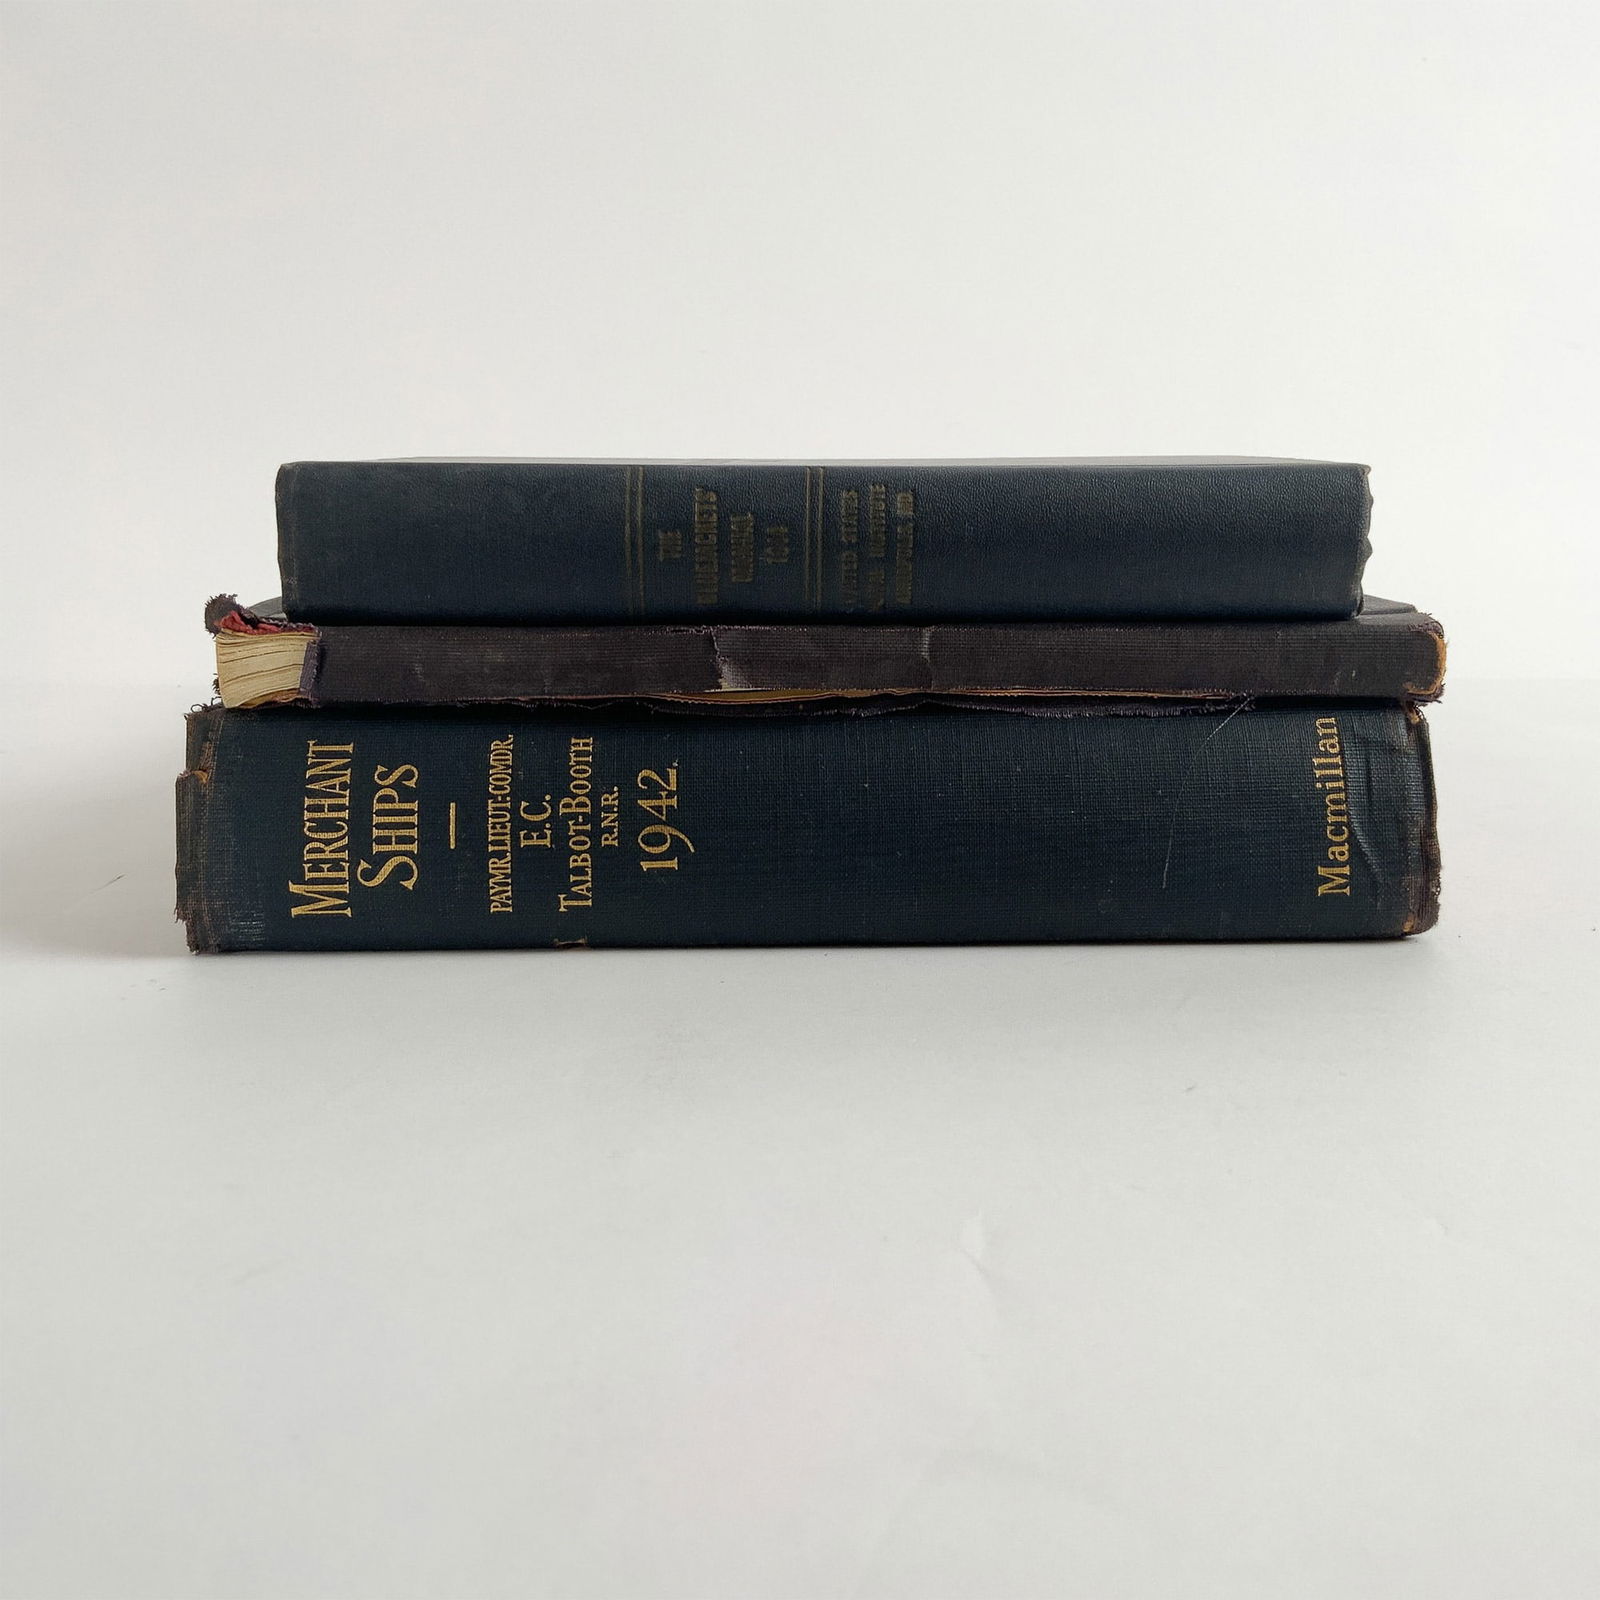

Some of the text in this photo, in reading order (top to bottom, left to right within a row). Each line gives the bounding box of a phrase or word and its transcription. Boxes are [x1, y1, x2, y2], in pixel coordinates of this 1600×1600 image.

[288, 740, 354, 918] MERCHANT
[356, 764, 419, 891] SHIPS
[519, 794, 552, 849] E.C.
[600, 786, 620, 848] R.N.R.
[1312, 717, 1351, 897] Macmillan
